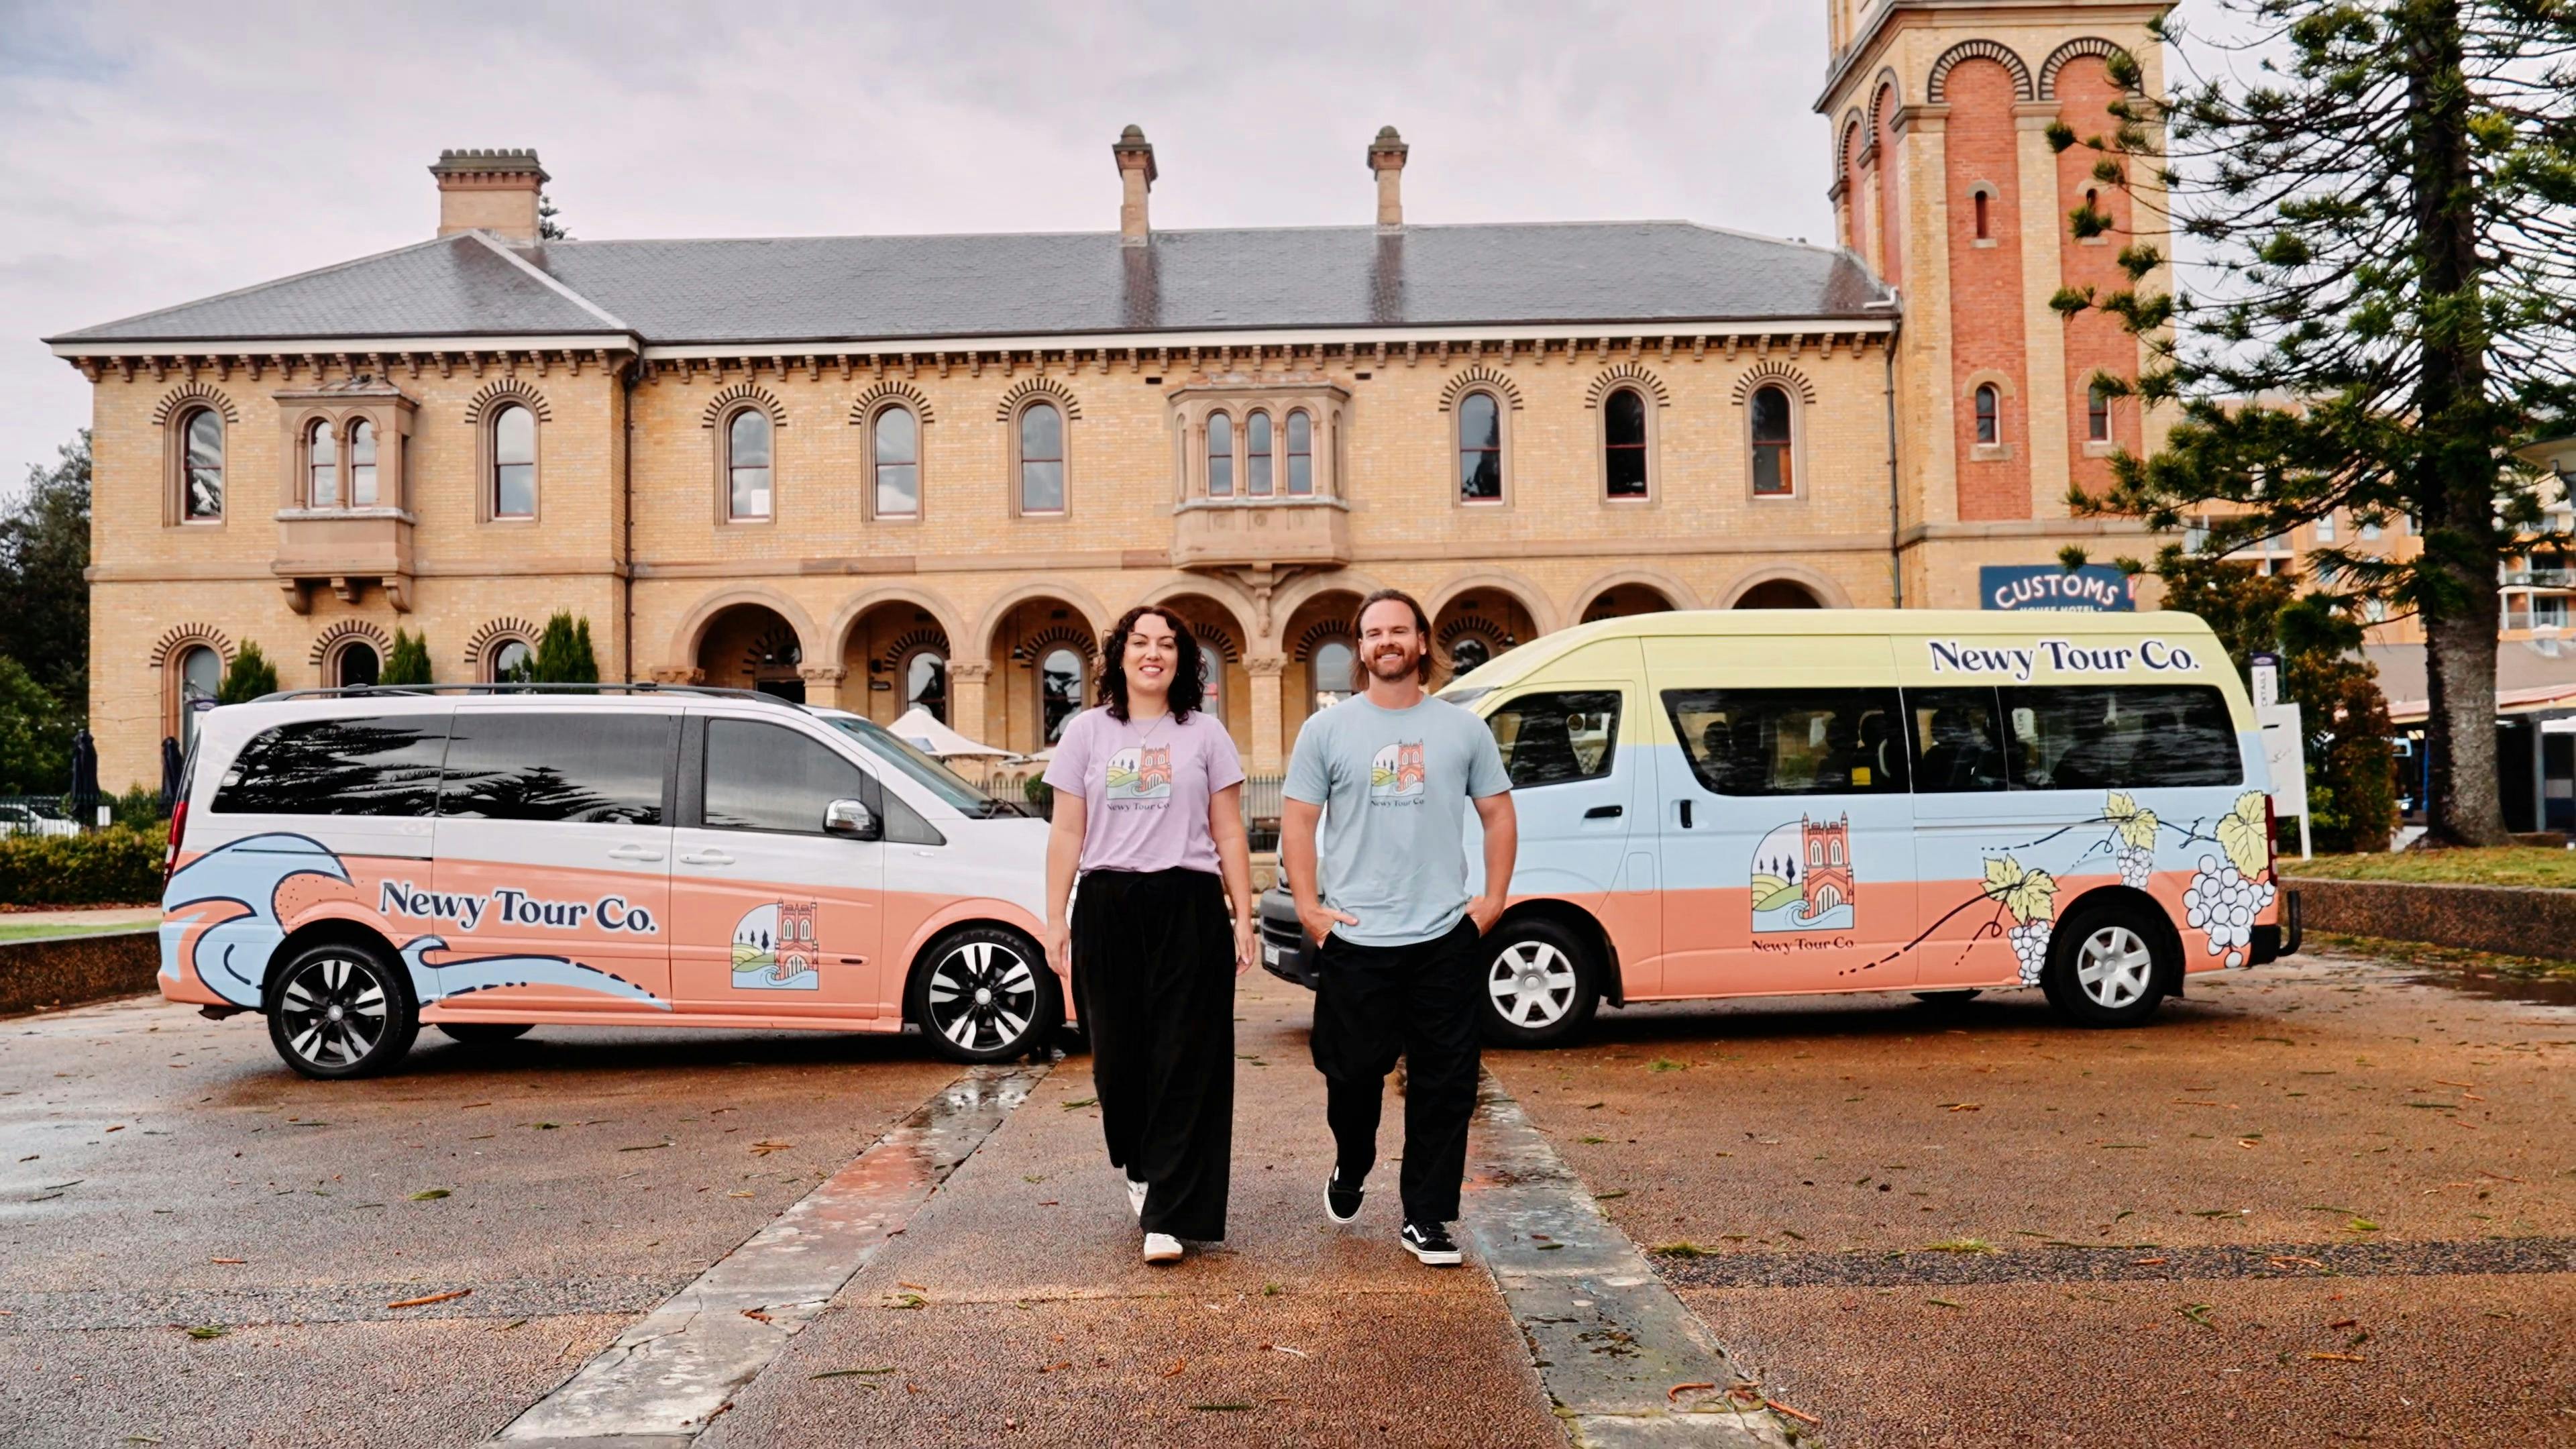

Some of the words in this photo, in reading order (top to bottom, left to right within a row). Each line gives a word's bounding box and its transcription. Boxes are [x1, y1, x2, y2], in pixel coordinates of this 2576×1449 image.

[1996, 575, 2118, 608] CUSTOMS
[1929, 642, 2033, 680] Newy
[2041, 641, 2132, 670] Tour
[2141, 641, 2199, 669] Co.
[1107, 803, 1130, 812] Newy
[381, 881, 486, 928] Newy
[495, 891, 588, 926] Tour
[596, 900, 656, 932] Co.
[1752, 940, 1792, 955] Newy
[1795, 938, 1830, 950] Tour
